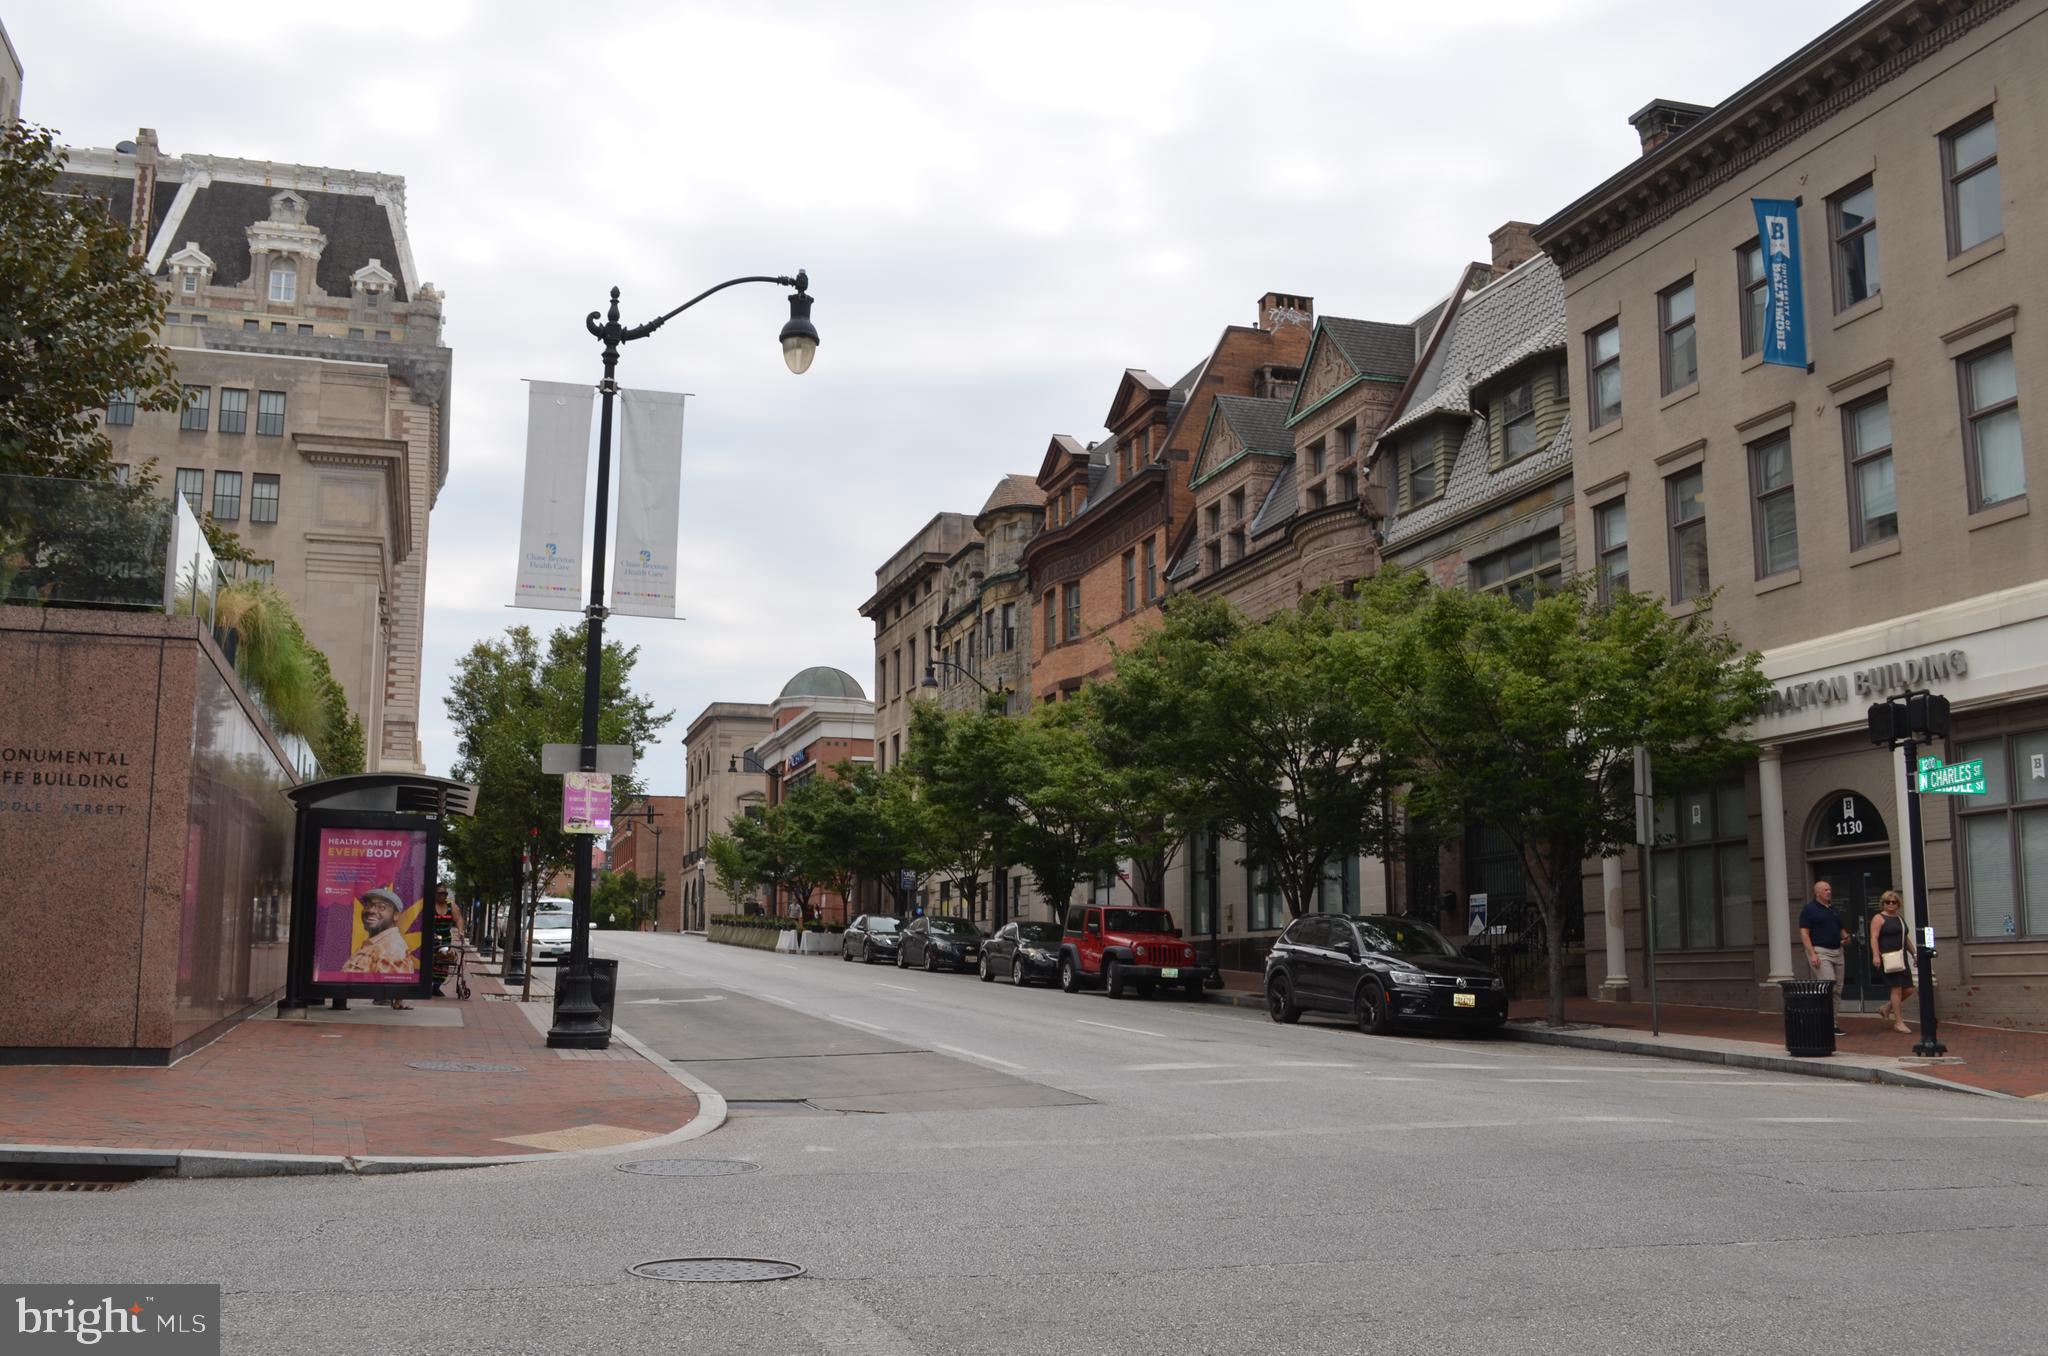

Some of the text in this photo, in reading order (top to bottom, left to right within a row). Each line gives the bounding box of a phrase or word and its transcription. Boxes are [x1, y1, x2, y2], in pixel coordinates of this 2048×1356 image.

[1771, 222, 1785, 241] B
[1781, 263, 1790, 316] UNIVERSITY
[1772, 263, 1787, 351] BALTIMORE
[1854, 649, 1969, 696] BUILDING
[33, 771, 129, 789] BUILDING
[1921, 764, 1981, 789] N CHARLES ST
[1976, 780, 1985, 790] ST
[63, 803, 127, 816] STREET
[1836, 820, 1863, 836] 1130
[328, 838, 360, 846] HEALTH
[361, 839, 383, 847] CARE
[328, 847, 401, 858] EVERYBODY
